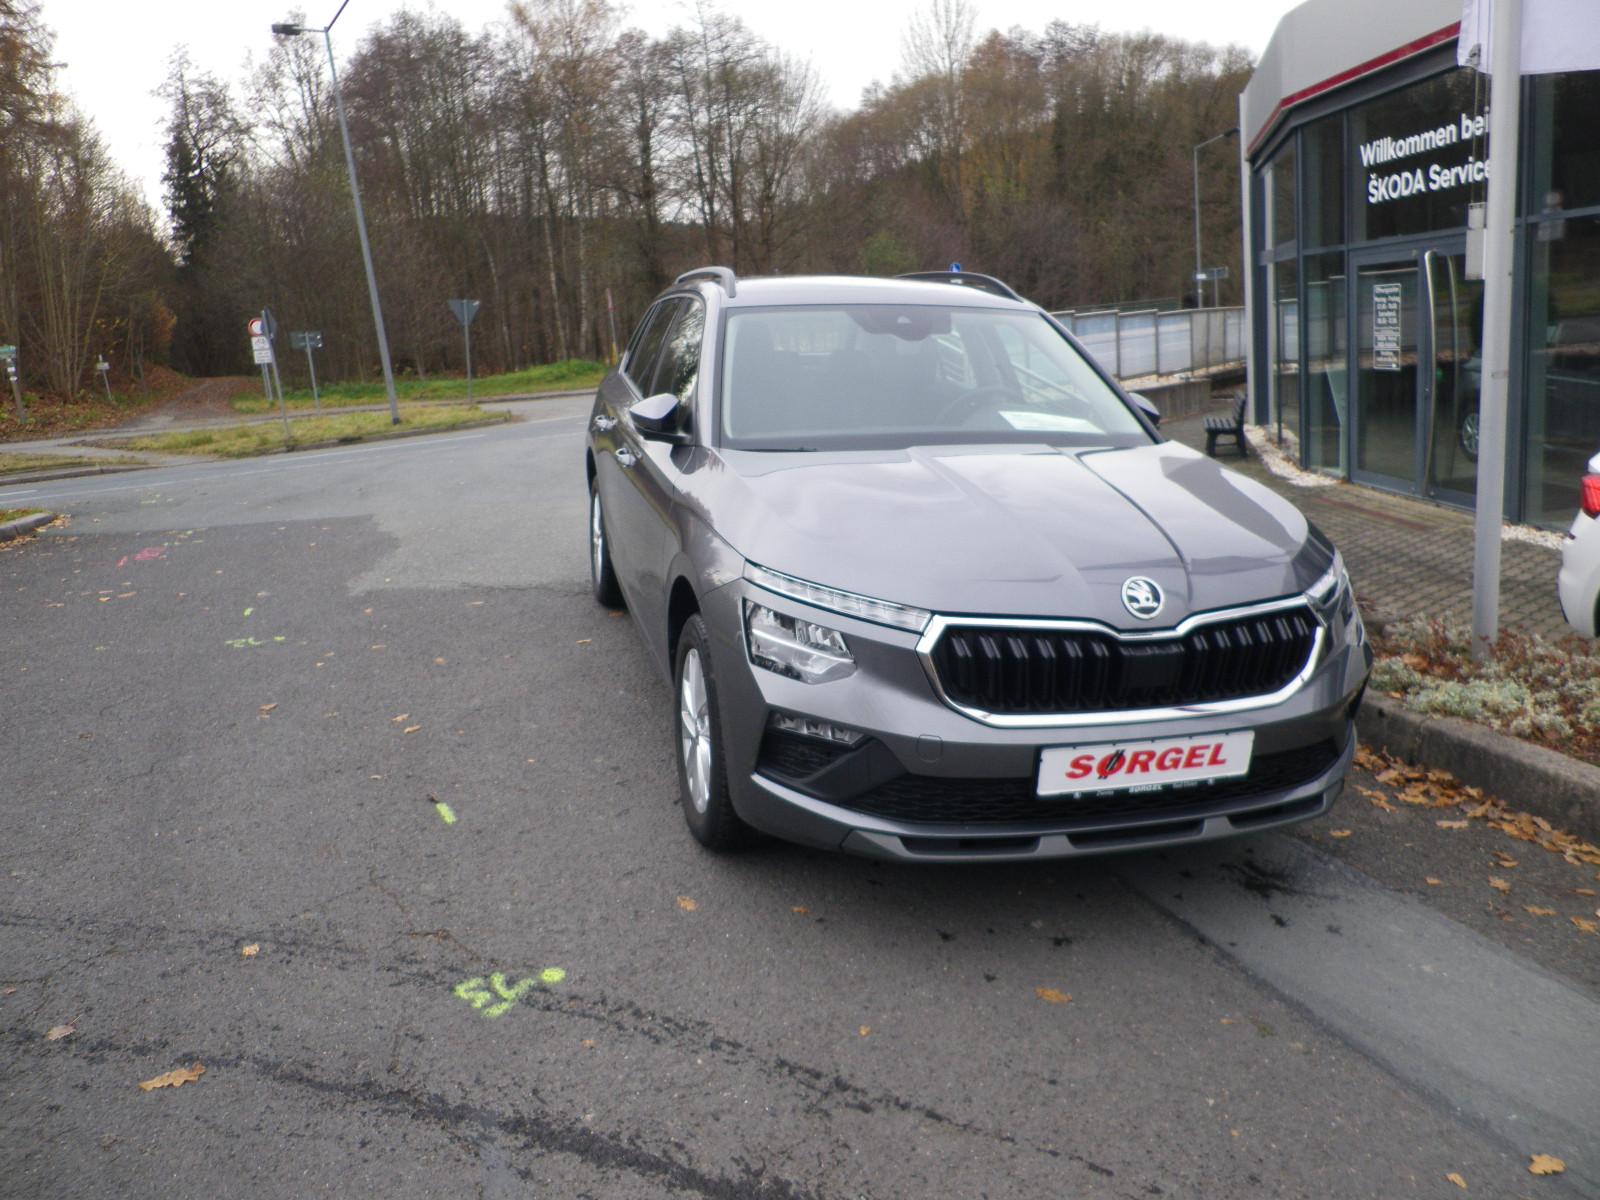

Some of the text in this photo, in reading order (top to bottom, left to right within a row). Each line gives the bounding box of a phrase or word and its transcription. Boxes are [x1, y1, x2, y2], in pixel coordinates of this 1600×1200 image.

[1360, 106, 1489, 167] Willkommen bei
[1368, 168, 1426, 203] ŠKODA
